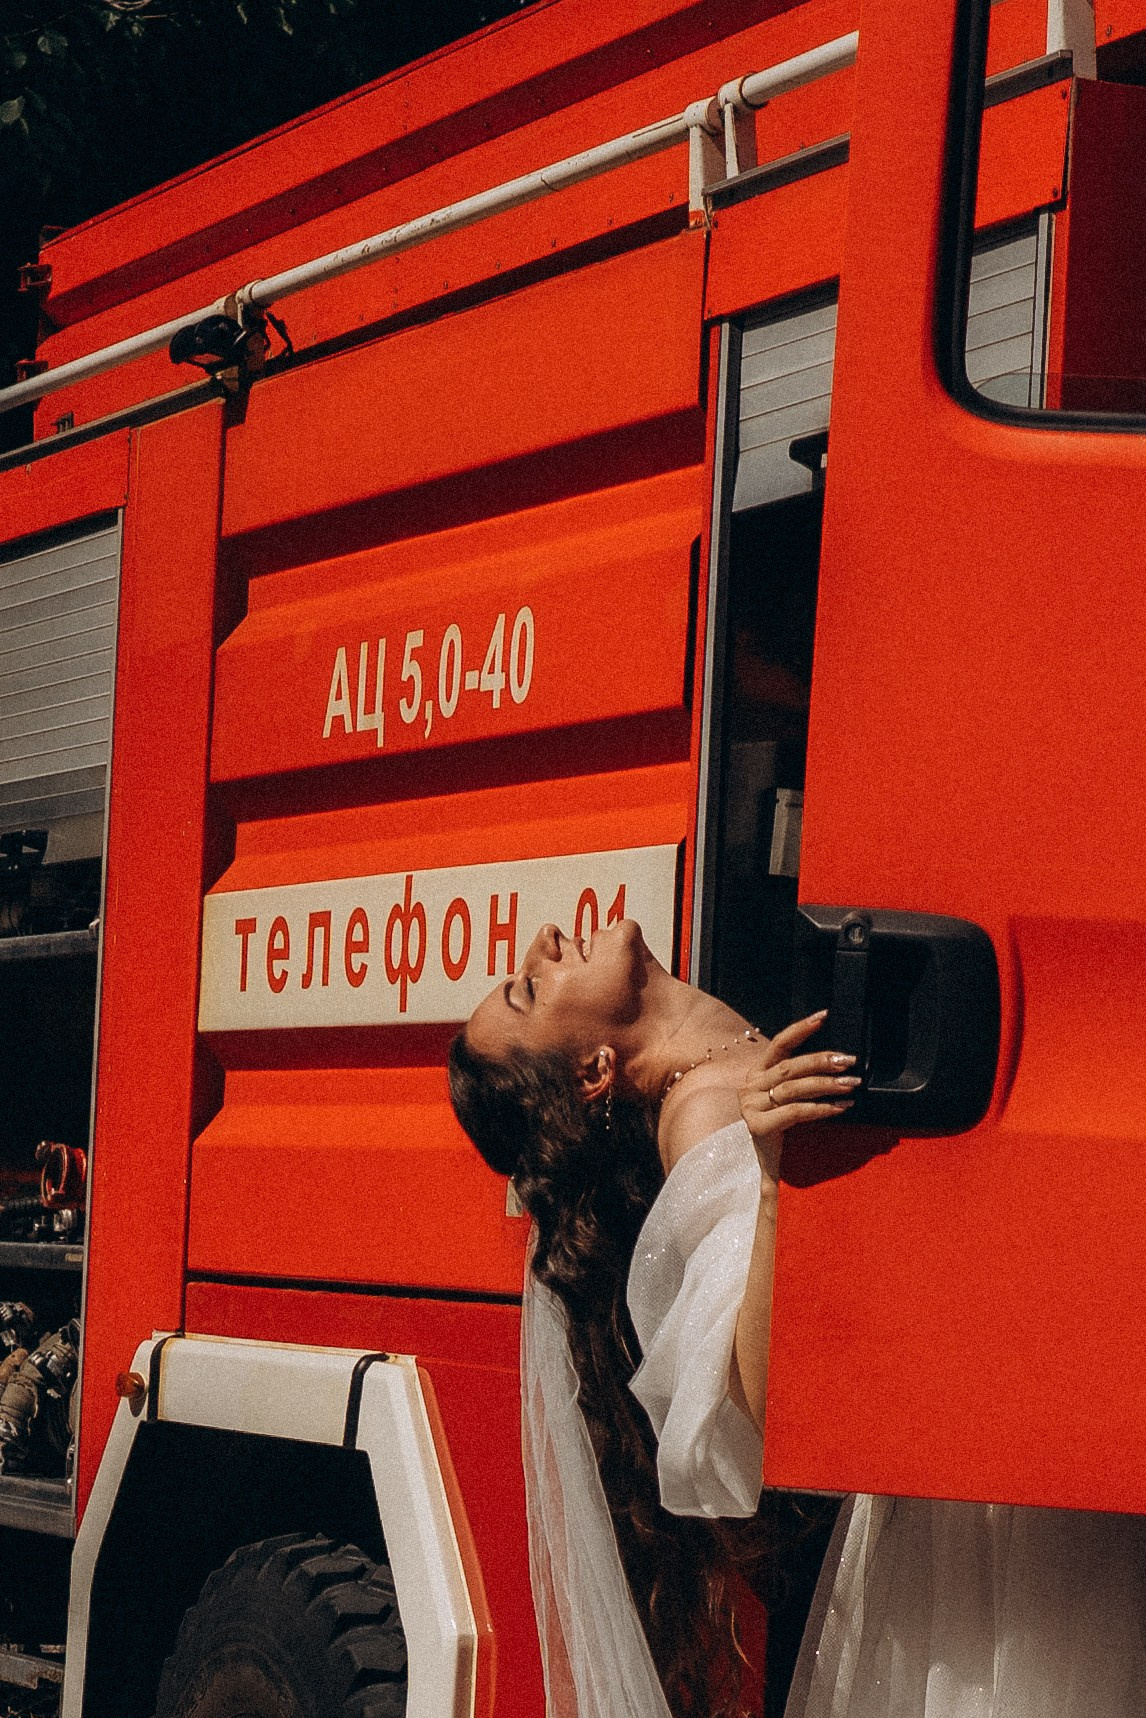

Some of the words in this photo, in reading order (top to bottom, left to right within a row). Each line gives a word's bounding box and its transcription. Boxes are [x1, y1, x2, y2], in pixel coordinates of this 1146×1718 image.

[322, 638, 386, 748] АЦ
[399, 605, 536, 739] 5,0-40
[235, 876, 519, 1012] телефон
